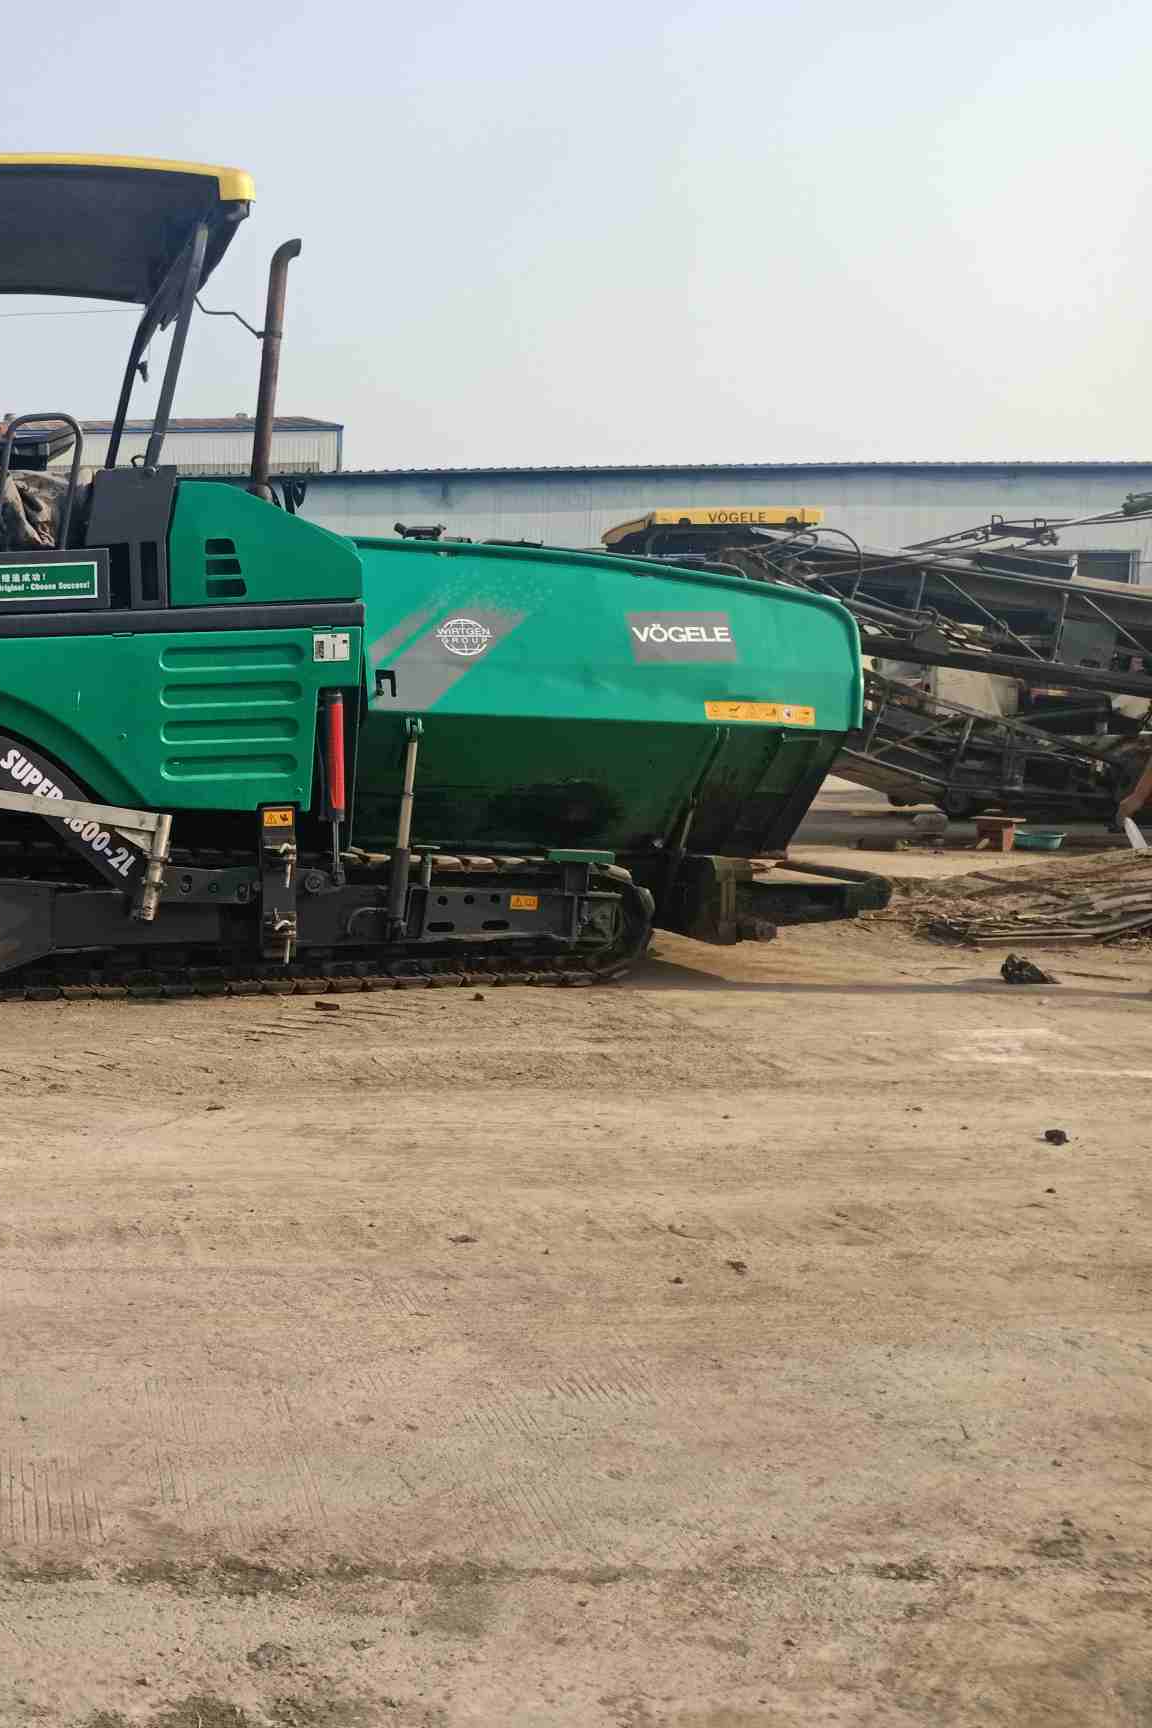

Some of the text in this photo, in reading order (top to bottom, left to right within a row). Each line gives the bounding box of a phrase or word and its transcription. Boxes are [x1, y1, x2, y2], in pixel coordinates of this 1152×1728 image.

[31, 583, 56, 591] Choose
[436, 627, 491, 636] WIRTGEN
[631, 623, 731, 642] VÖGELE
[440, 637, 488, 645] GROUP
[0, 749, 137, 877] SUPER 800-2L
